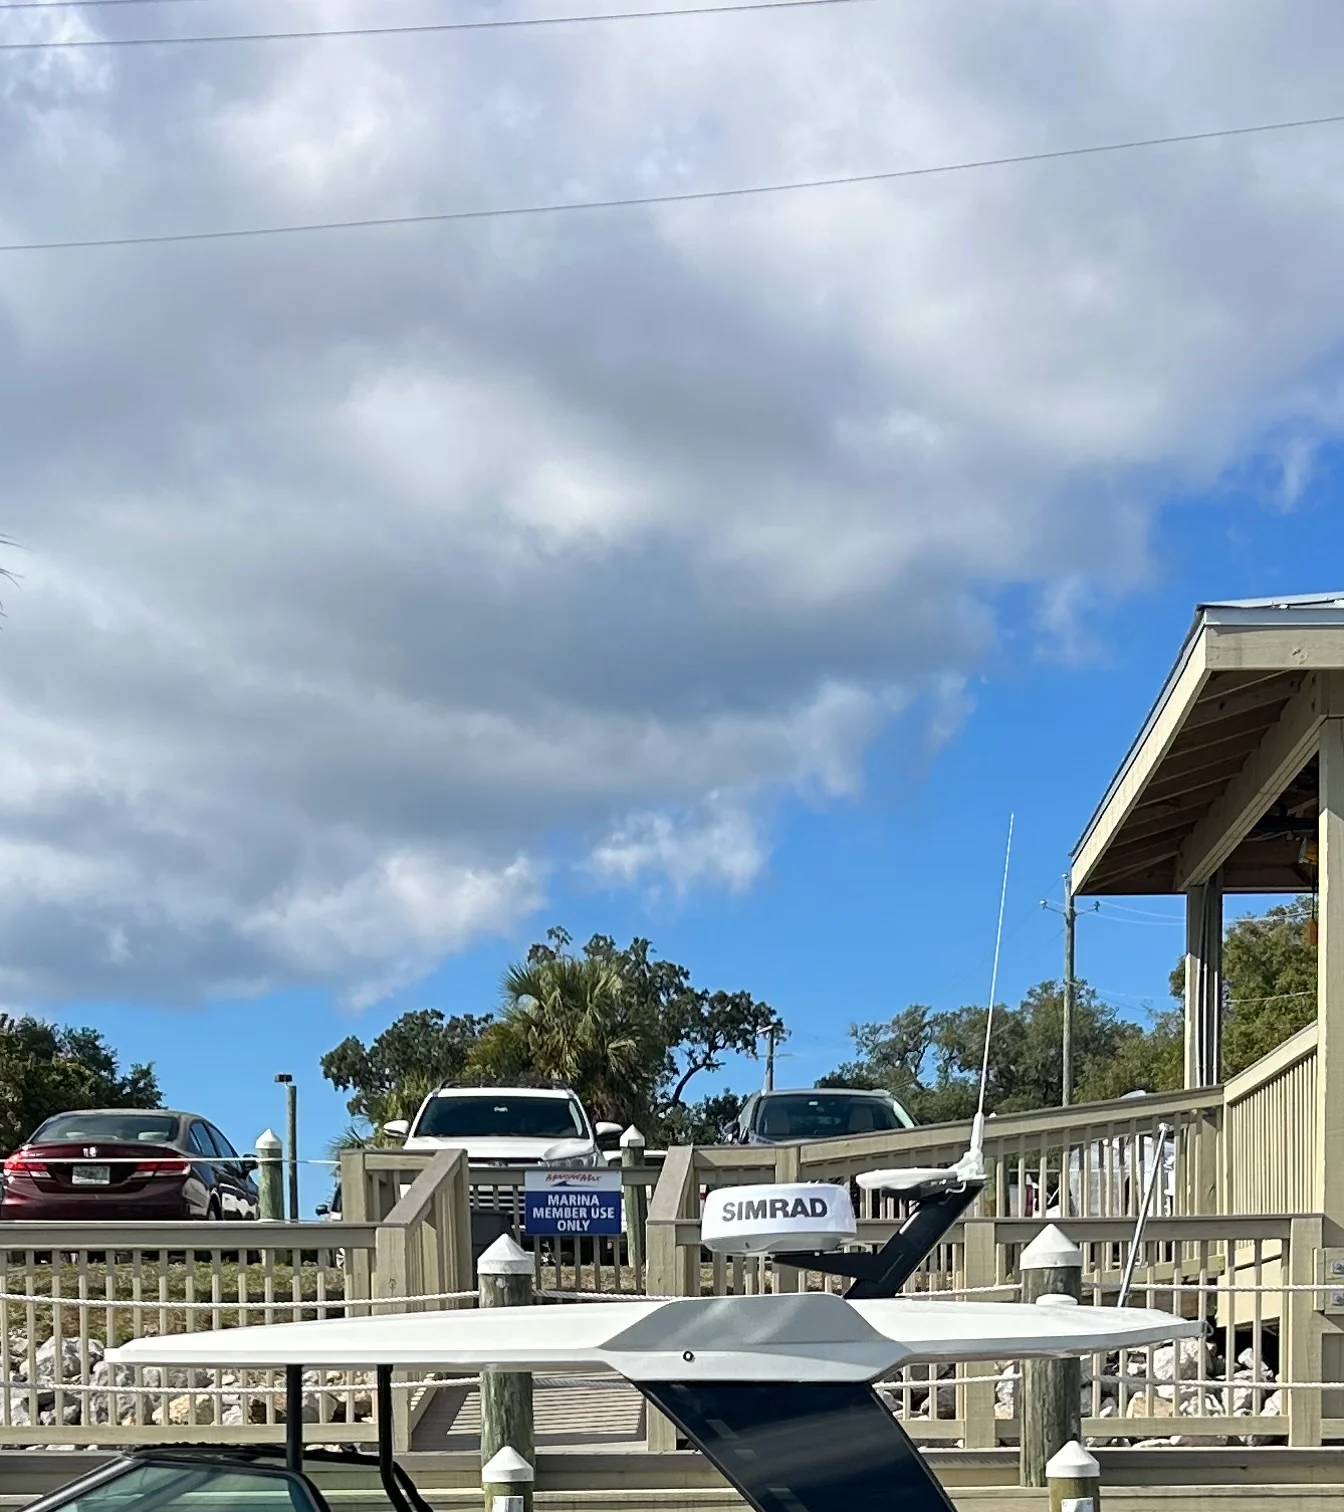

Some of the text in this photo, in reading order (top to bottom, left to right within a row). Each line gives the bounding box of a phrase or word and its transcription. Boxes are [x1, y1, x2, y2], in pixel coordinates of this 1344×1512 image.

[547, 1194, 600, 1207] MARINA
[532, 1207, 615, 1219] MEMBER USE
[722, 1198, 828, 1222] SIMRAD
[557, 1219, 591, 1232] ONLY
